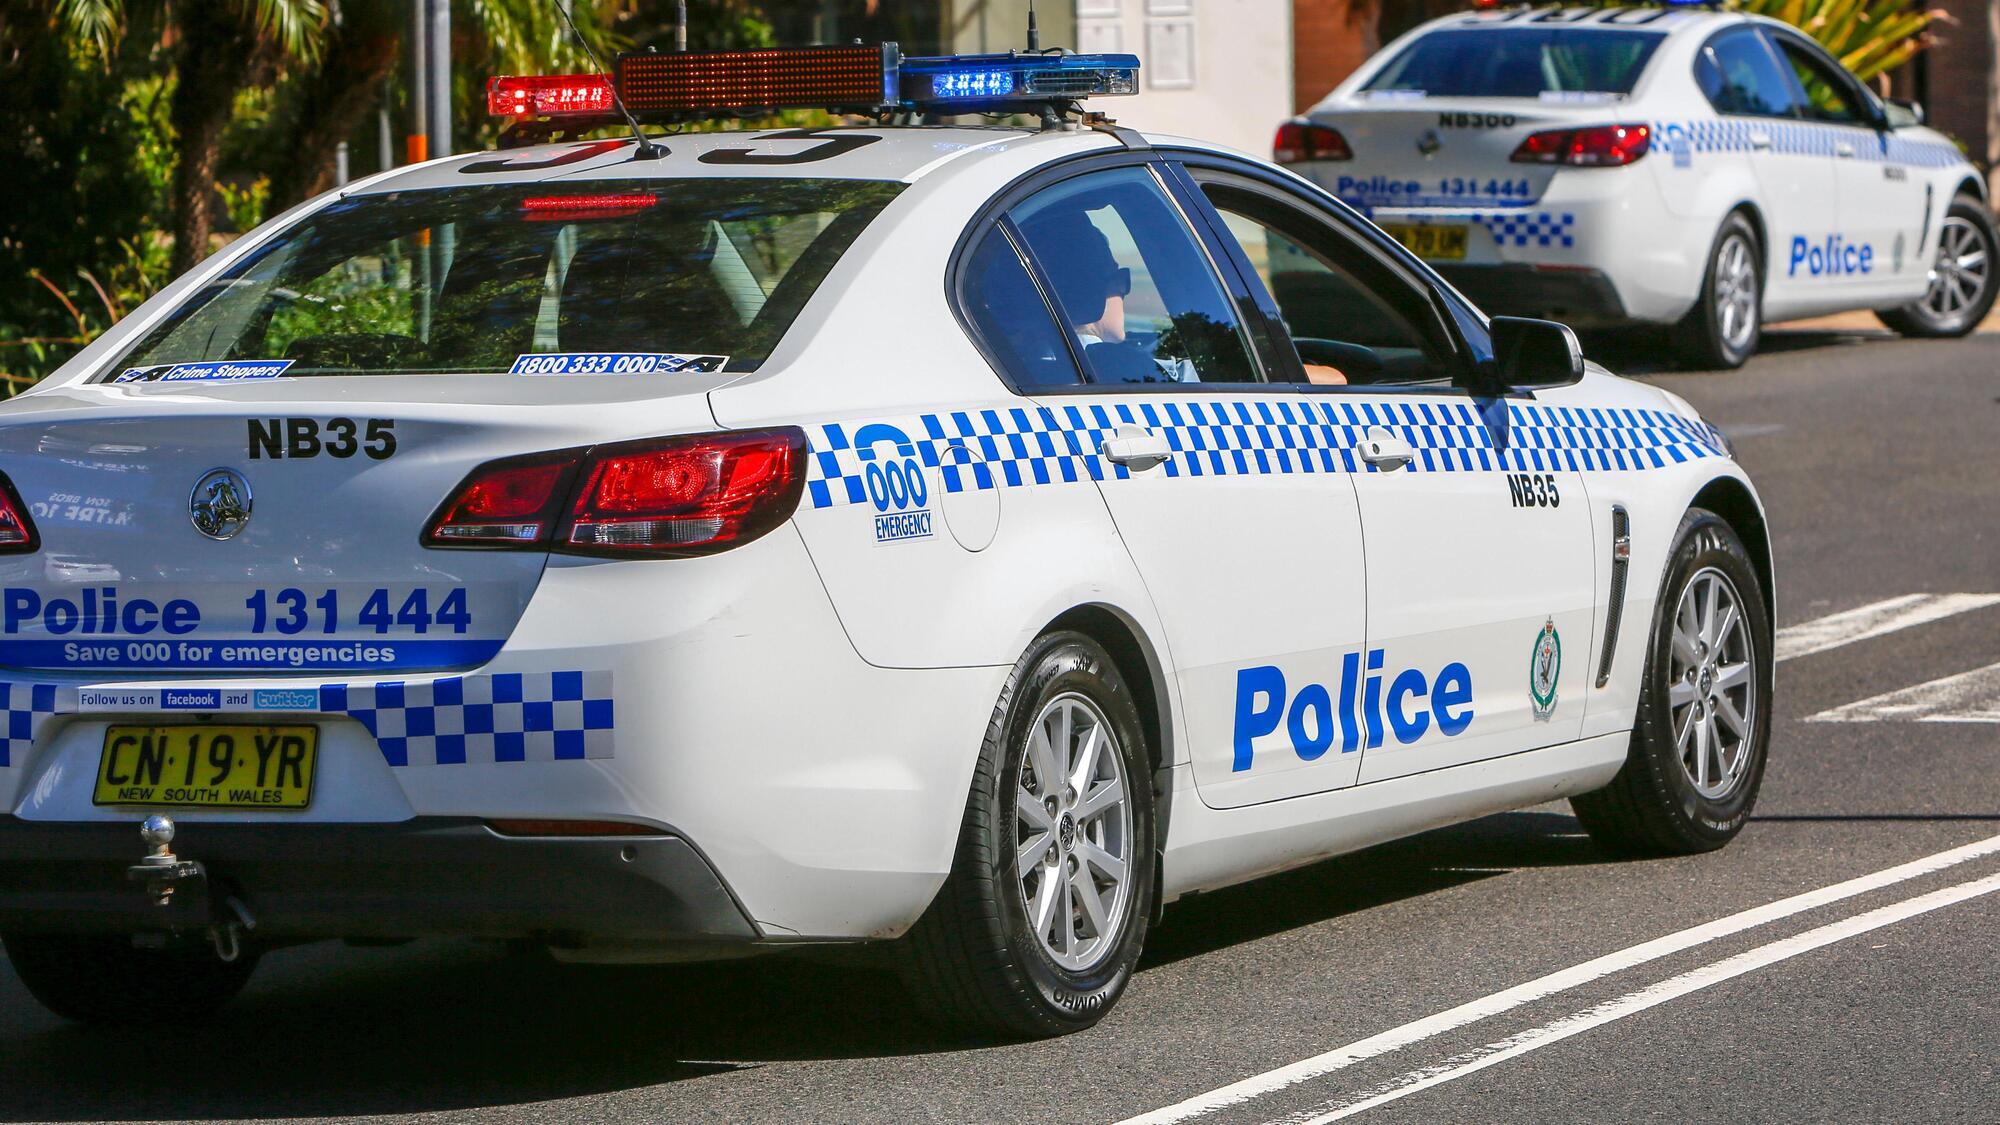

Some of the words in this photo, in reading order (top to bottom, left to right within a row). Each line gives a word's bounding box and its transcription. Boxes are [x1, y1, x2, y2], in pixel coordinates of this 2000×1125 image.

[690, 53, 778, 107] NOT
[1439, 112, 1517, 128] NB300
[1337, 176, 1421, 194] Police
[1440, 178, 1476, 195] 131
[1484, 179, 1529, 196] 444
[1788, 233, 1874, 278] Police
[168, 366, 212, 380] Crime
[215, 364, 282, 380] Stoppers
[517, 356, 568, 374] 1800
[568, 356, 612, 374] 333
[613, 356, 657, 373] 000
[247, 417, 398, 460] NB35
[865, 458, 928, 512] 000
[1507, 473, 1561, 508] NB35
[875, 512, 932, 539] EMERGENCY
[4, 588, 201, 635] Police
[246, 588, 339, 635] 131
[358, 587, 472, 635] 444
[64, 642, 120, 662] Save
[127, 642, 171, 661] 000
[178, 642, 213, 661] for
[221, 643, 396, 666] emergencies
[81, 693, 118, 706] Follow
[122, 695, 136, 705] us
[139, 695, 155, 705] on
[167, 693, 215, 706] facebook
[226, 693, 249, 705] and
[257, 691, 315, 708] twitter
[1231, 648, 1475, 773] Police
[118, 787, 155, 801] NEW
[163, 788, 220, 803] SOUTH
[229, 789, 283, 804] WALES
[1053, 989, 1107, 1011] KUMHO
